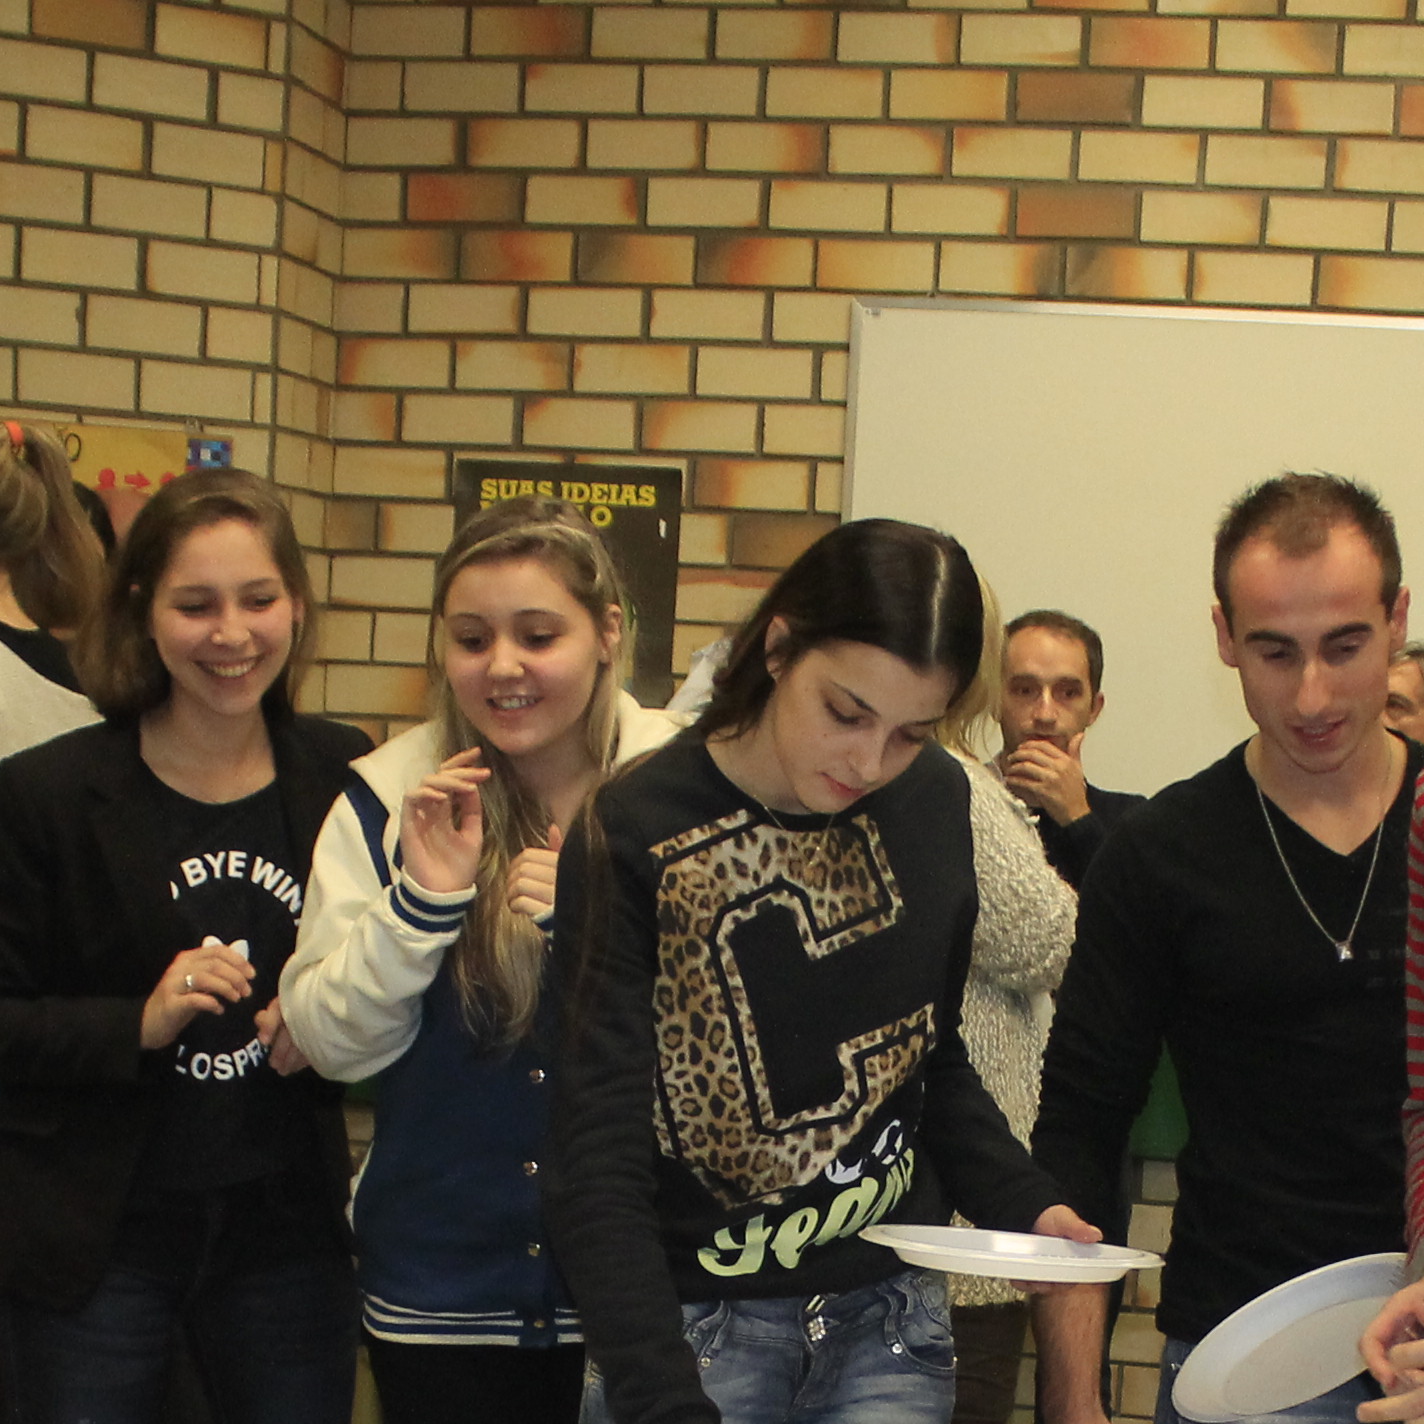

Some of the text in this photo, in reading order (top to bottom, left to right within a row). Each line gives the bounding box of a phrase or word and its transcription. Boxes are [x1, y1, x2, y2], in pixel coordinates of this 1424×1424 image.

[480, 478, 553, 500] SUAS
[560, 481, 657, 507] IDEIAS
[180, 850, 303, 926] BYE WIN
